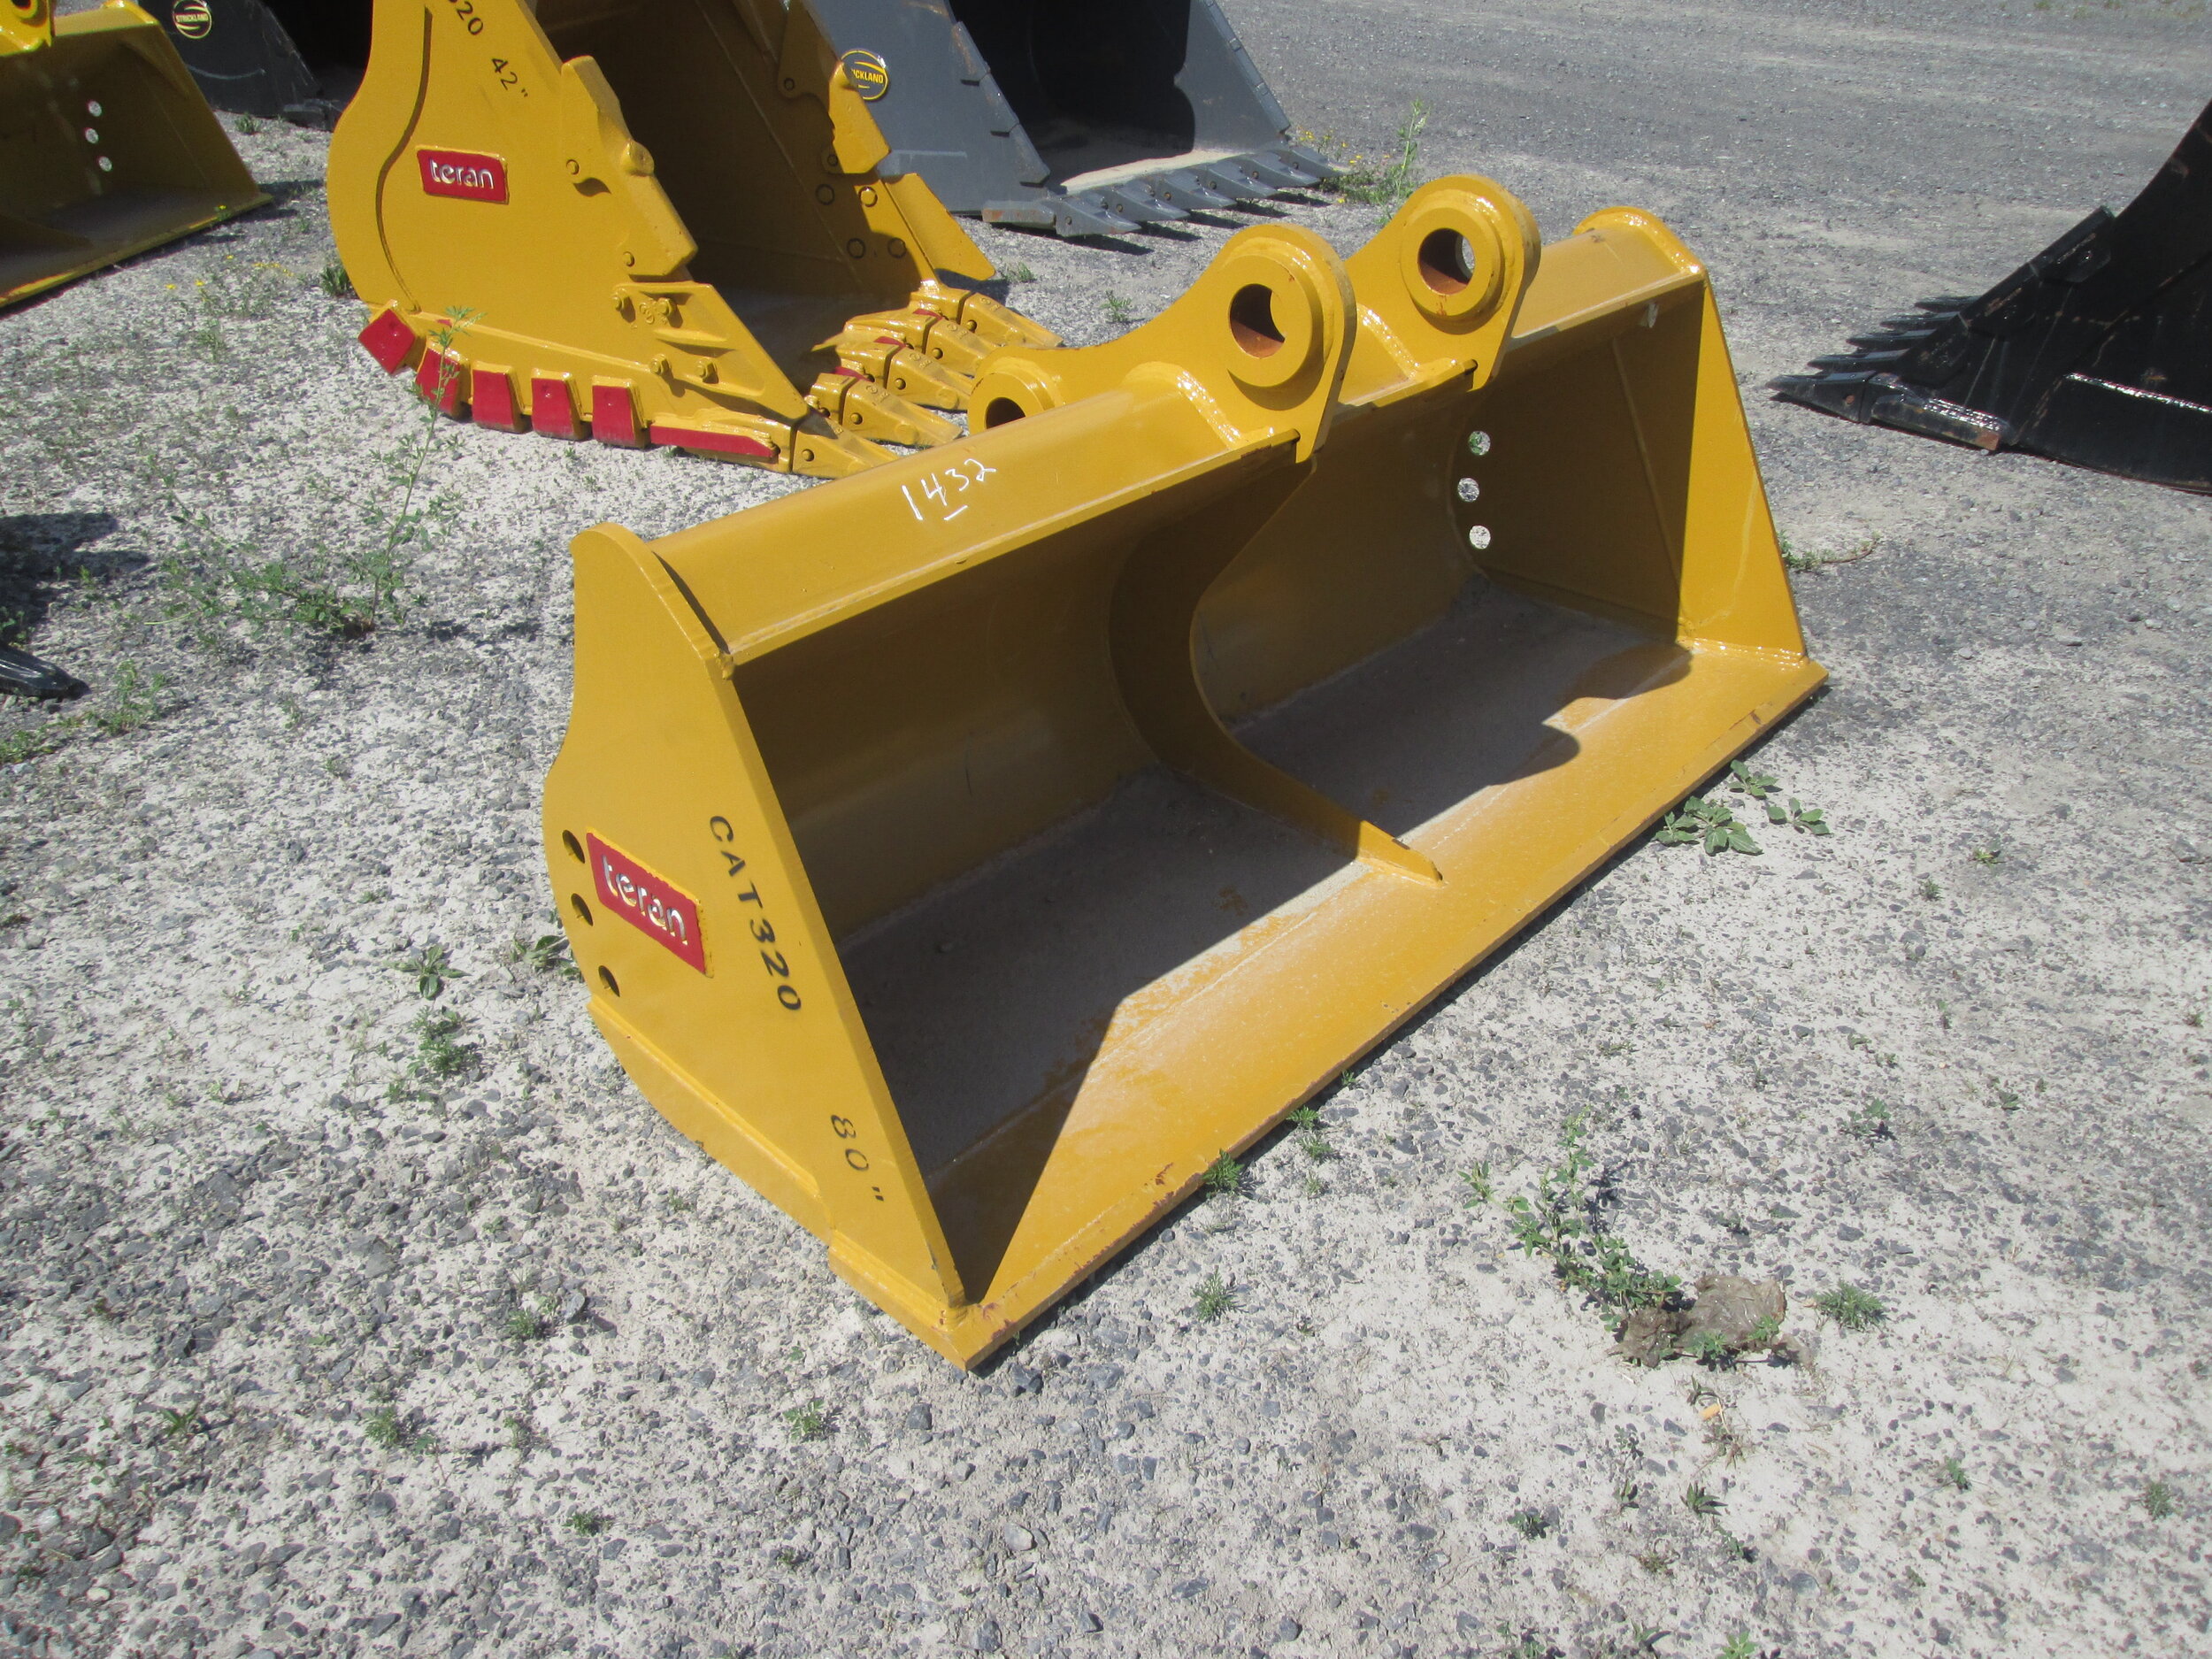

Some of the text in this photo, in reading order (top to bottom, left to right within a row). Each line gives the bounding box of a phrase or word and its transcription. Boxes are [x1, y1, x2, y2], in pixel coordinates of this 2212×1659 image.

[448, 0, 484, 36] 20
[429, 158, 495, 190] teran
[901, 457, 997, 521] 1432
[602, 854, 688, 946] teran
[710, 815, 802, 1011] CAT320
